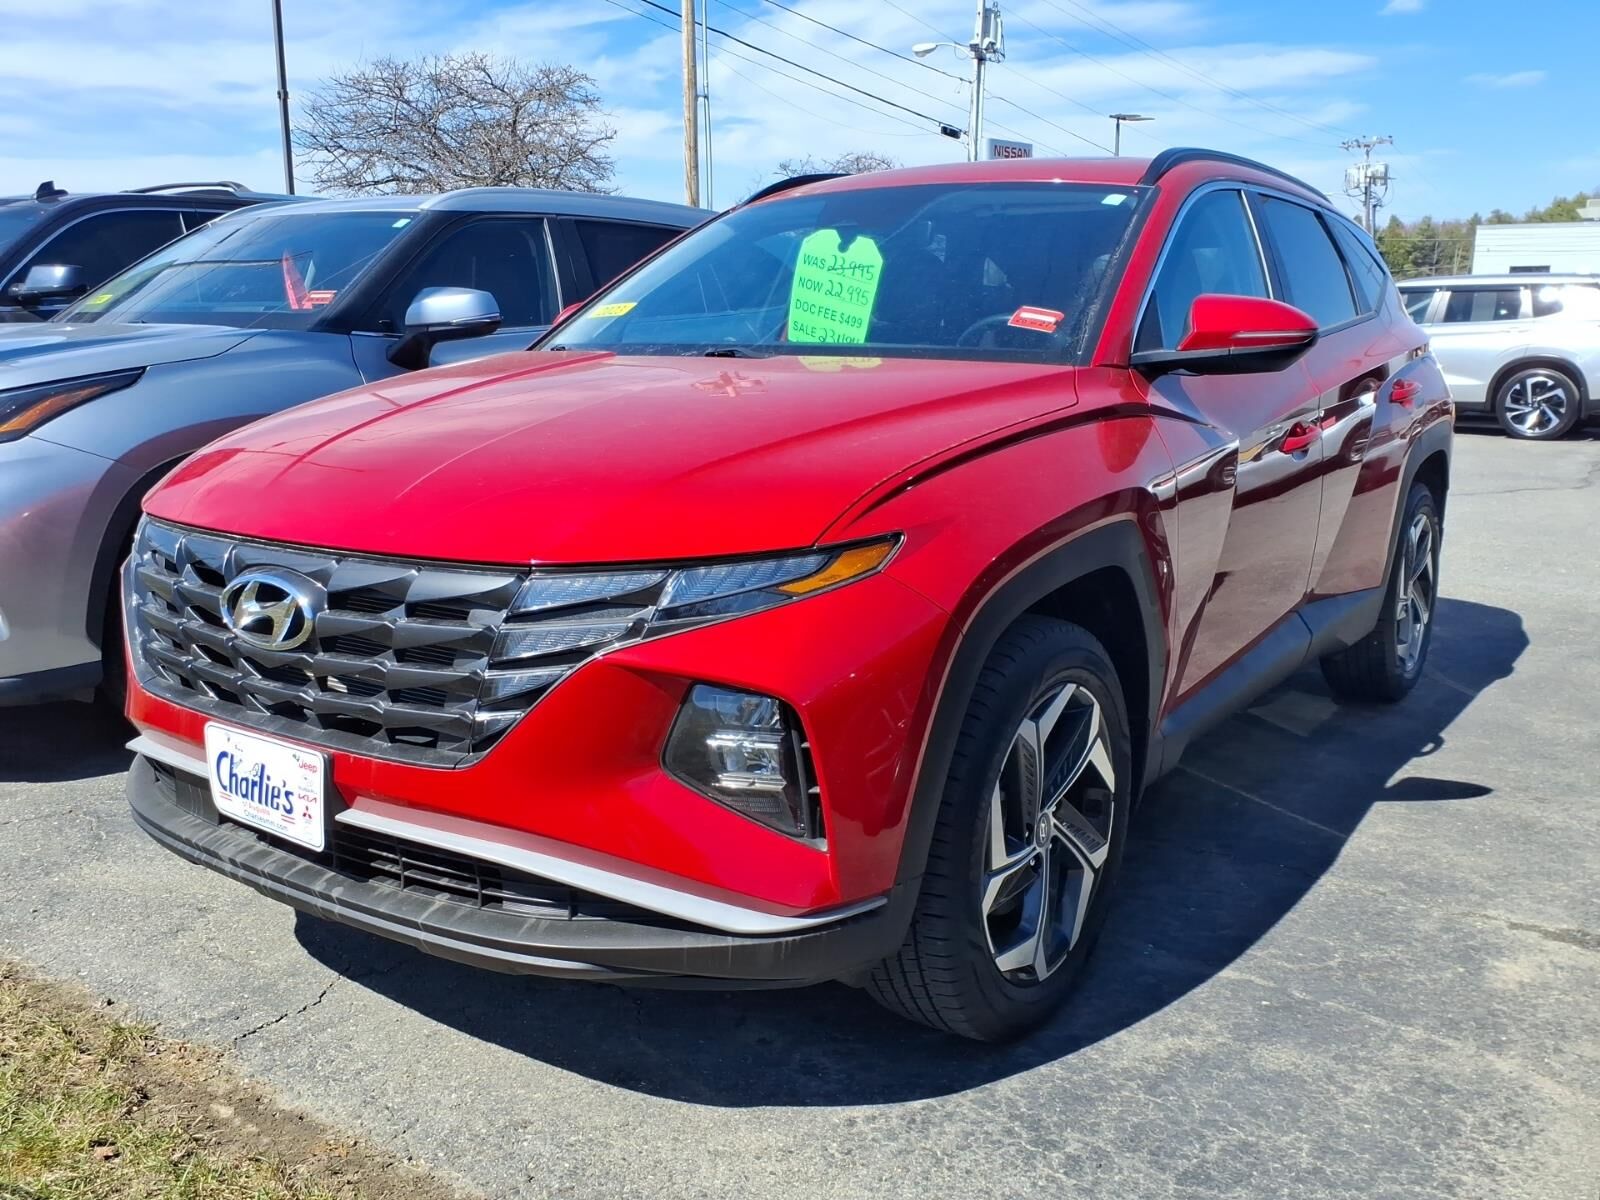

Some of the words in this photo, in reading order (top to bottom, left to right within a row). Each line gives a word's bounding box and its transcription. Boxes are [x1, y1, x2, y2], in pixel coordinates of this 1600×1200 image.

[994, 145, 1031, 158] NISSAN
[803, 254, 826, 270] WAS
[798, 276, 823, 293] NOW
[795, 299, 817, 315] DOC
[817, 306, 838, 322] FEE
[839, 312, 863, 329] $499
[793, 320, 817, 338] SALE
[298, 761, 318, 774] Jeep
[216, 751, 295, 815] Charlie's
